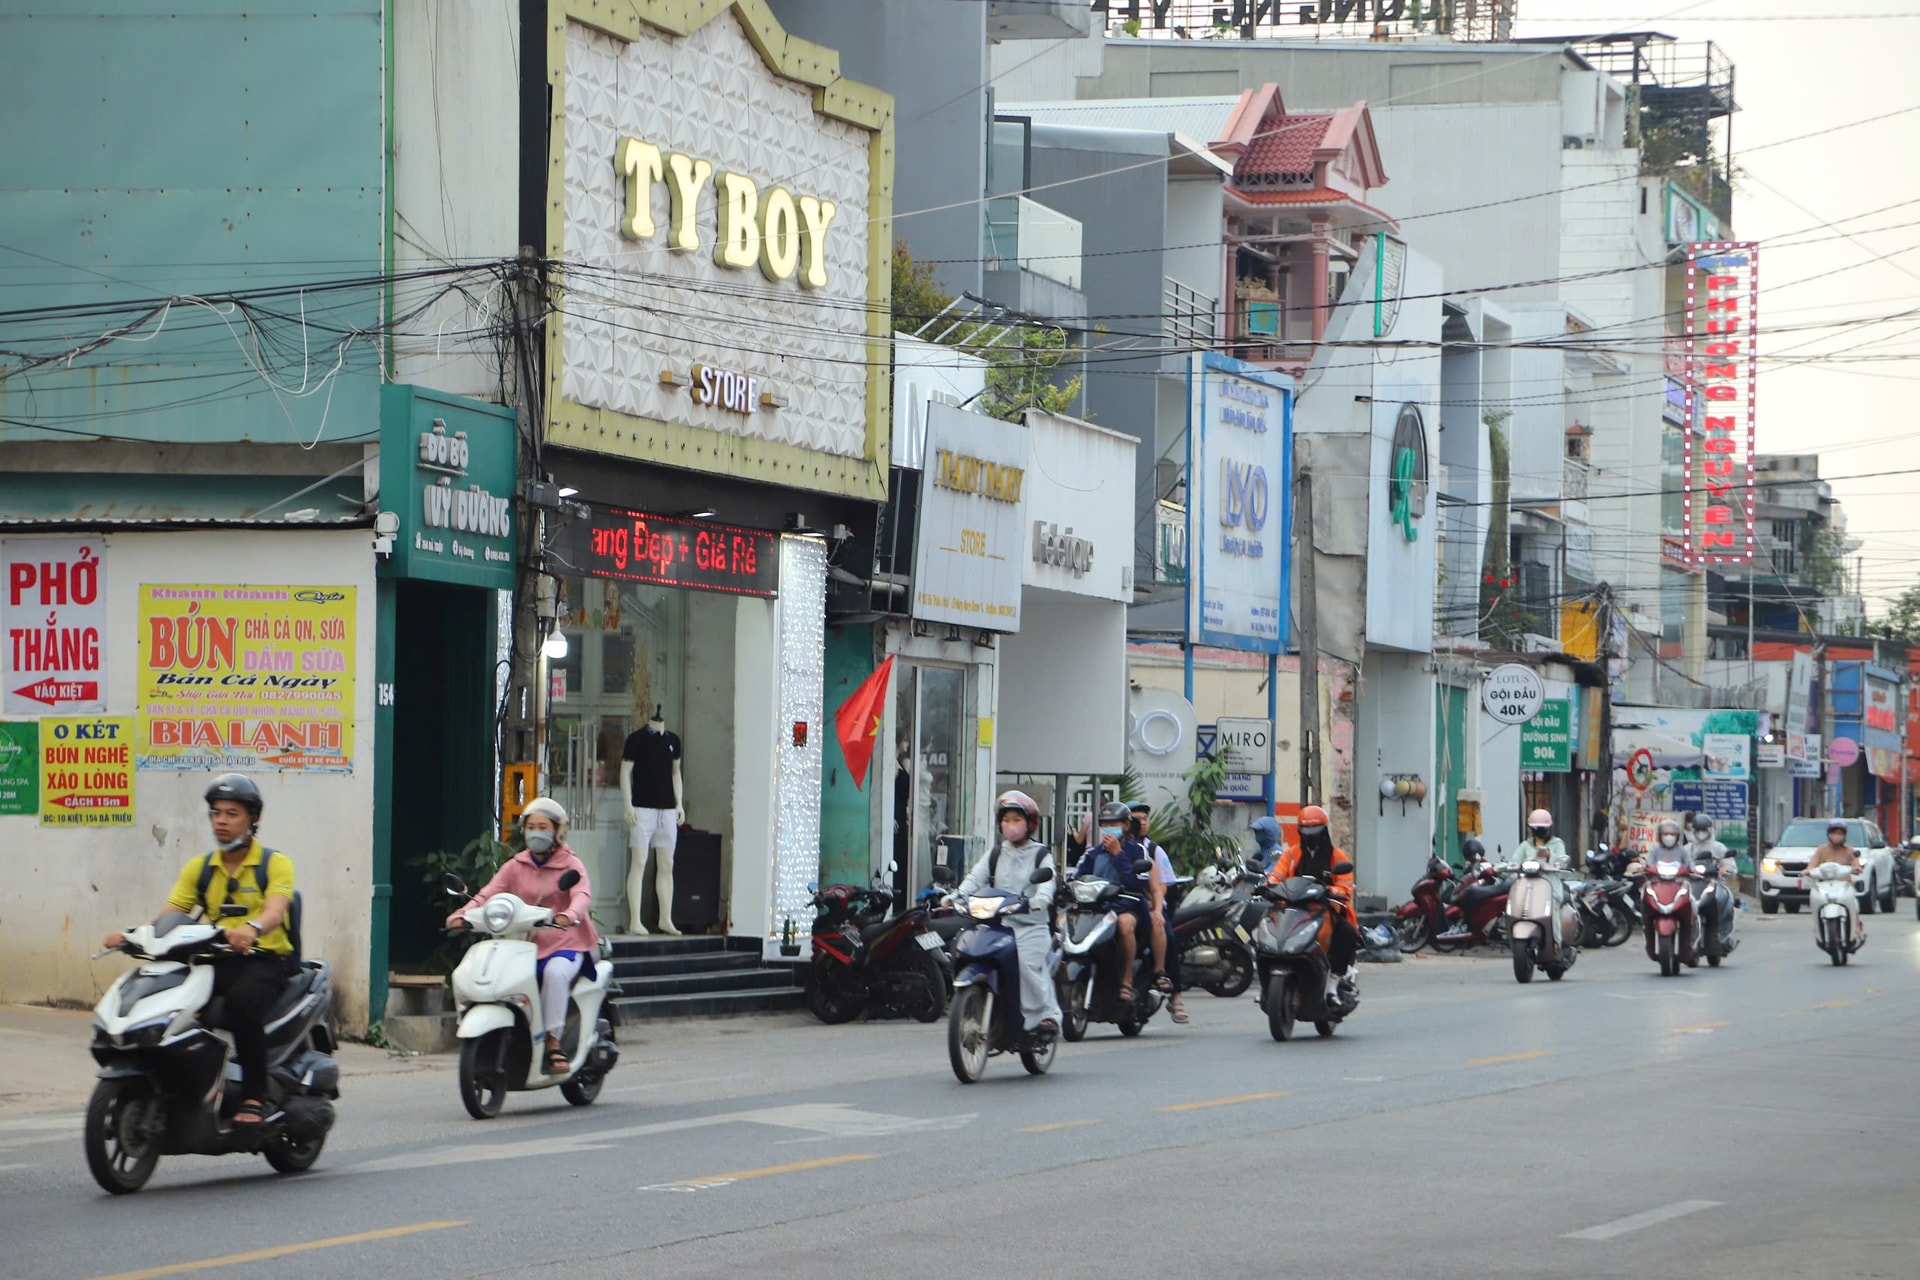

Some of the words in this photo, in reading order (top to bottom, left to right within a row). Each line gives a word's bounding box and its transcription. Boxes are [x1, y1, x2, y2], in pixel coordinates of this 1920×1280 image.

[614, 137, 713, 253] TY
[714, 171, 836, 289] BOY
[690, 364, 757, 414] STORE
[633, 521, 675, 576] Đẹp
[695, 530, 727, 571] Giá
[731, 533, 757, 576] Rẻ
[960, 529, 986, 557] STORE
[10, 546, 99, 606] PHỞ
[149, 601, 239, 671] BÚN
[244, 613, 270, 640] CHẢ
[274, 615, 290, 640] CÁ
[295, 620, 316, 642] QN,
[320, 616, 345, 640] SỨA
[10, 611, 99, 672] THẮNG
[243, 643, 294, 671] DẤM
[301, 647, 346, 672] SỨA
[34, 683, 57, 698] VÀO
[59, 682, 83, 700] KIỆT
[156, 672, 213, 685] Bán
[263, 674, 336, 689] Ngày
[1497, 675, 1530, 684] LOTUS
[378, 683, 394, 706] 154
[1490, 688, 1510, 702] GỘI
[1500, 704, 1526, 716] 40K
[54, 724, 69, 739] O
[150, 719, 224, 747] BIA
[228, 720, 342, 753] LẠNH
[1221, 732, 1266, 747] MIRO
[45, 743, 79, 764] BÚN
[84, 743, 129, 768] NGHỆ
[1533, 746, 1556, 759] 90k
[47, 768, 79, 789] XÀO
[84, 768, 128, 789] LÒNG
[64, 795, 94, 807] CÁCH
[97, 797, 121, 807] 15m
[67, 814, 83, 823] KIỆT
[112, 813, 132, 823] TRIỆU
